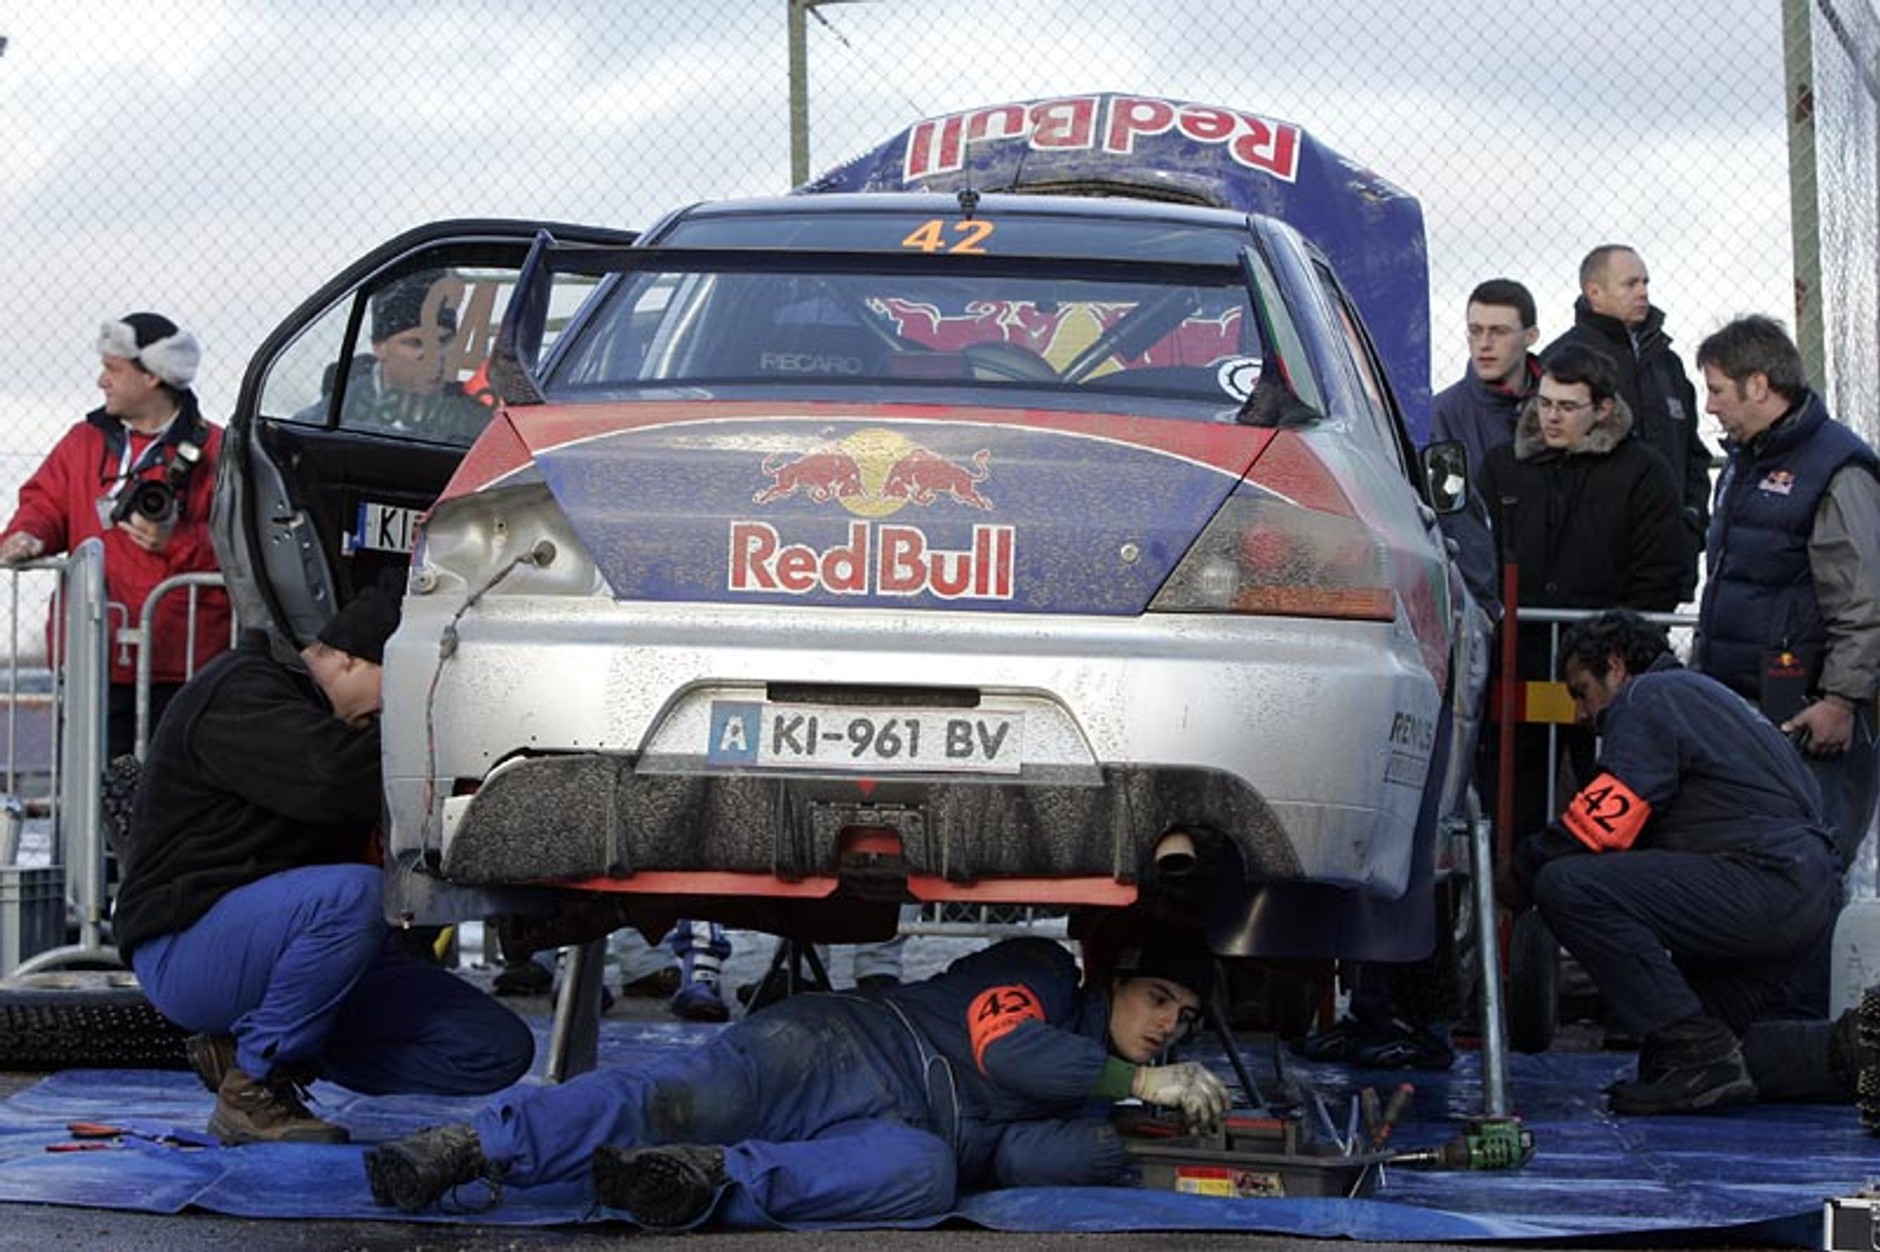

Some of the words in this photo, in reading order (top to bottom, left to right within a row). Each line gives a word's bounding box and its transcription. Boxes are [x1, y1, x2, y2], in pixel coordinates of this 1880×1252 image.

[903, 97, 1100, 181] Bull
[1103, 96, 1301, 183] Red
[902, 219, 994, 253] 42
[730, 521, 870, 595] Red
[877, 524, 1015, 599] Bull
[720, 715, 748, 751] A
[772, 714, 921, 758] KI-961
[945, 719, 1010, 760] BV
[1584, 785, 1631, 834] 42
[977, 989, 1032, 1023] 42
